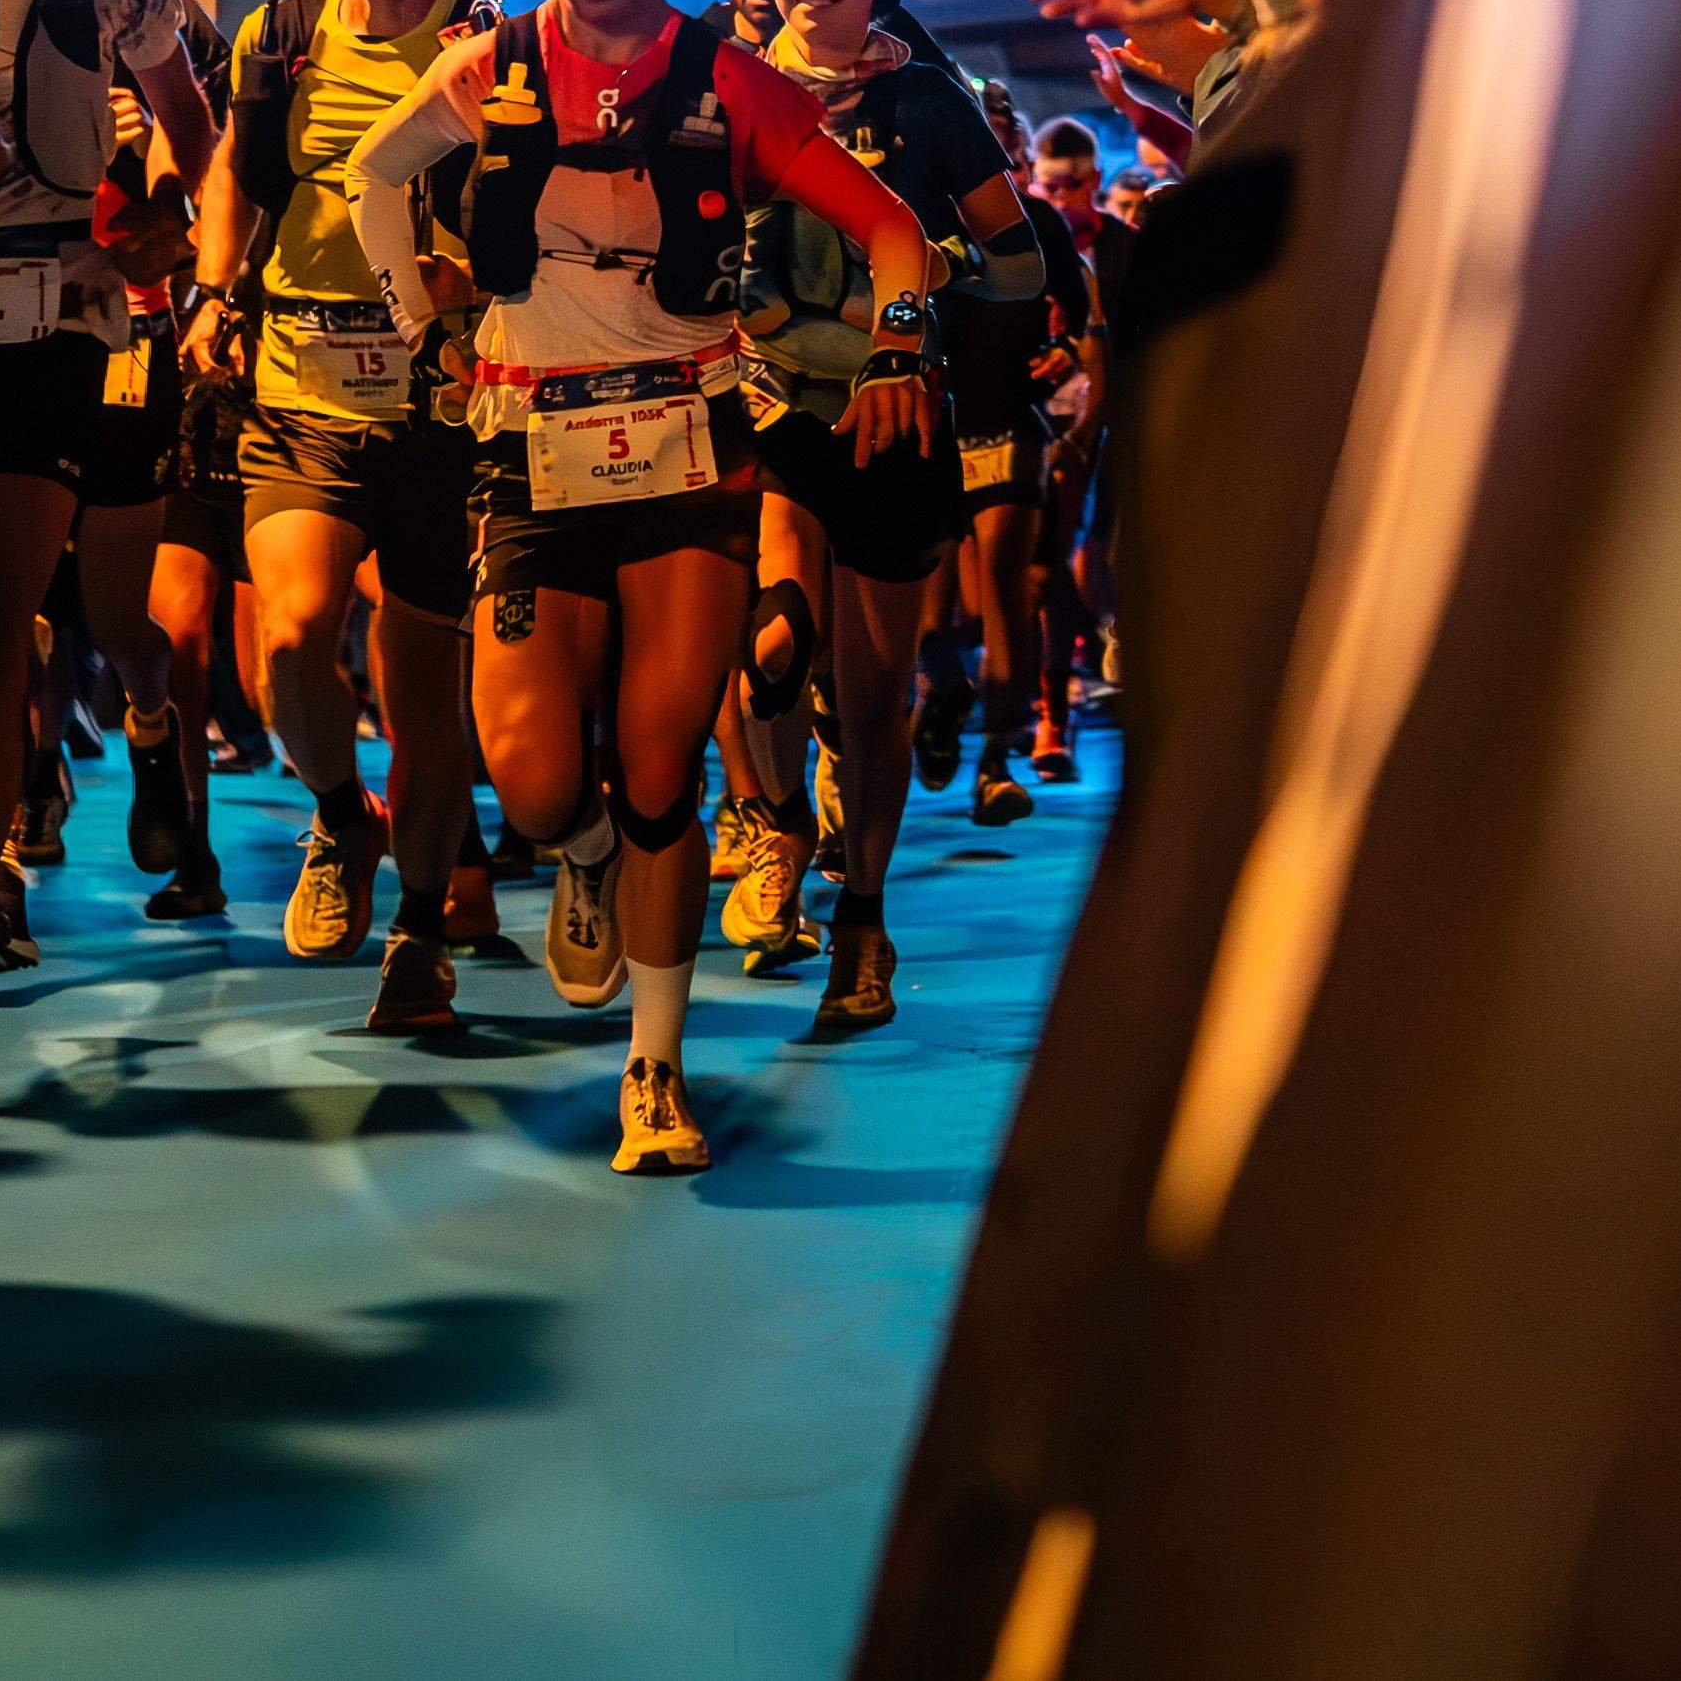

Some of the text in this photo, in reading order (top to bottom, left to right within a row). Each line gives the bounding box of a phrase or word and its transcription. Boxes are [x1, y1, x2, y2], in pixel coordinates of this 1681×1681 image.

[355, 352, 387, 376] 15
[608, 428, 630, 460] 5
[591, 459, 654, 478] CLAUDIA
